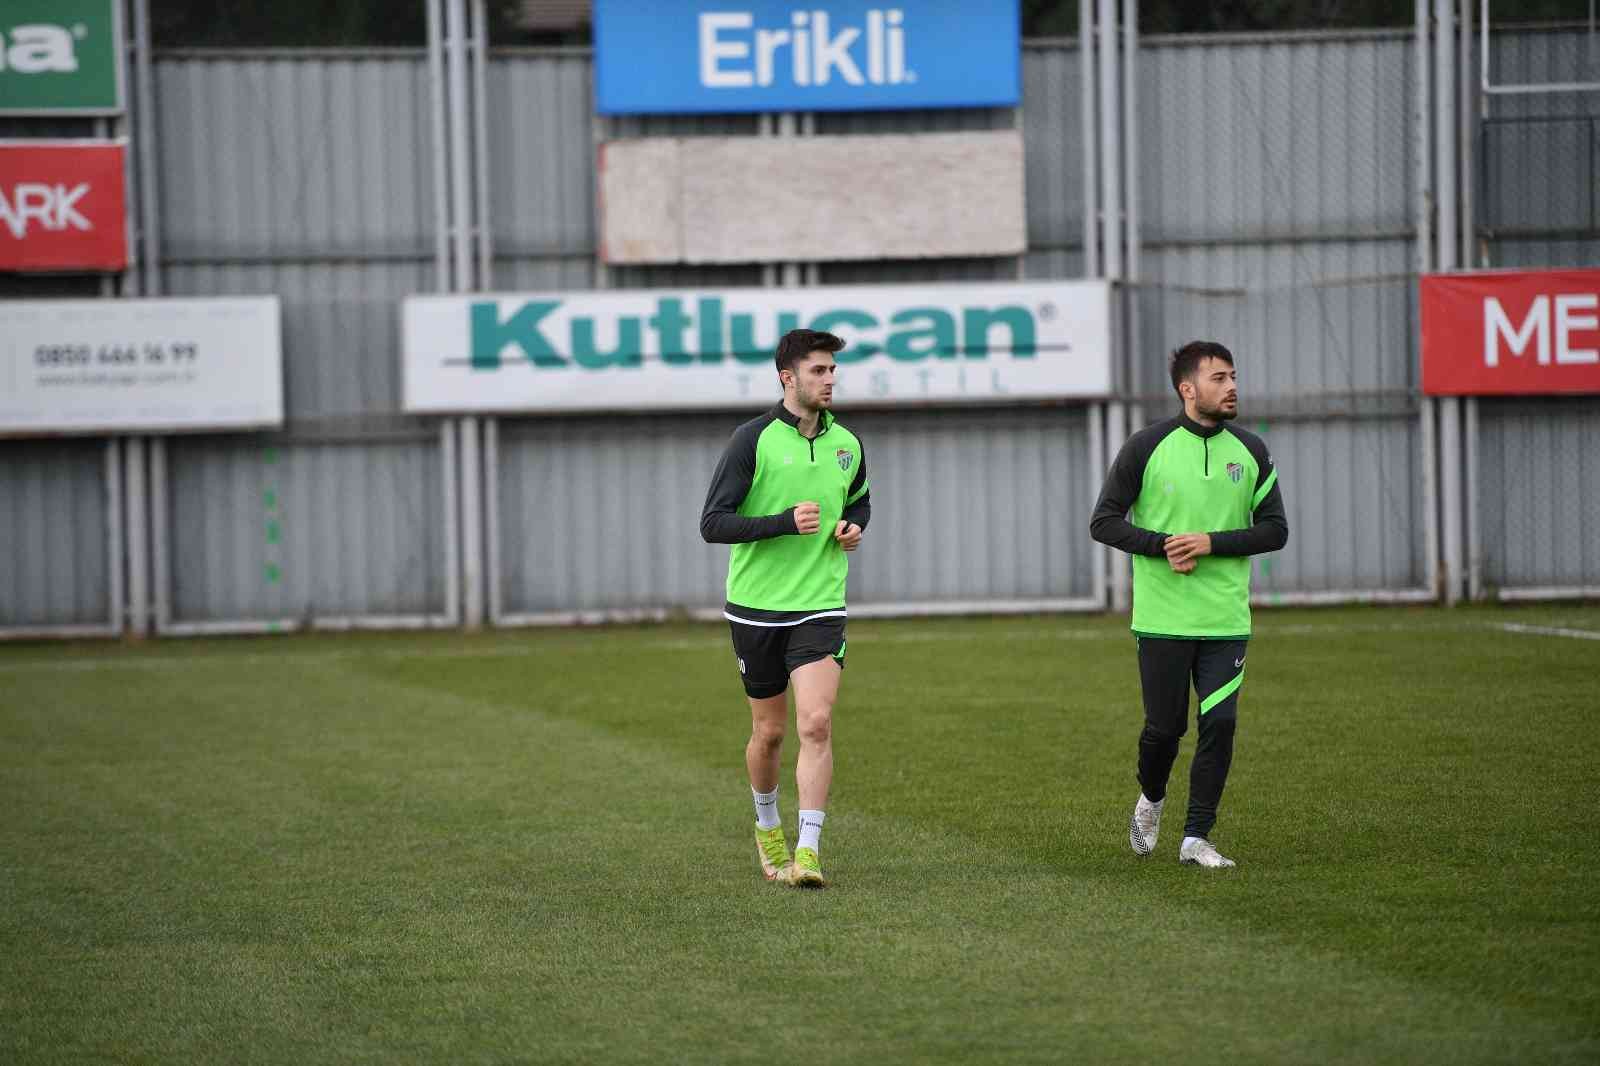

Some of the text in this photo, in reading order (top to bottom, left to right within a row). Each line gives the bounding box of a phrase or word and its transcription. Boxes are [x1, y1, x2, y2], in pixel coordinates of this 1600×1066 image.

[0, 23, 79, 73] a
[700, 10, 905, 87] Erikli
[470, 296, 1036, 370] Kutlucan
[1484, 294, 1599, 368] ME
